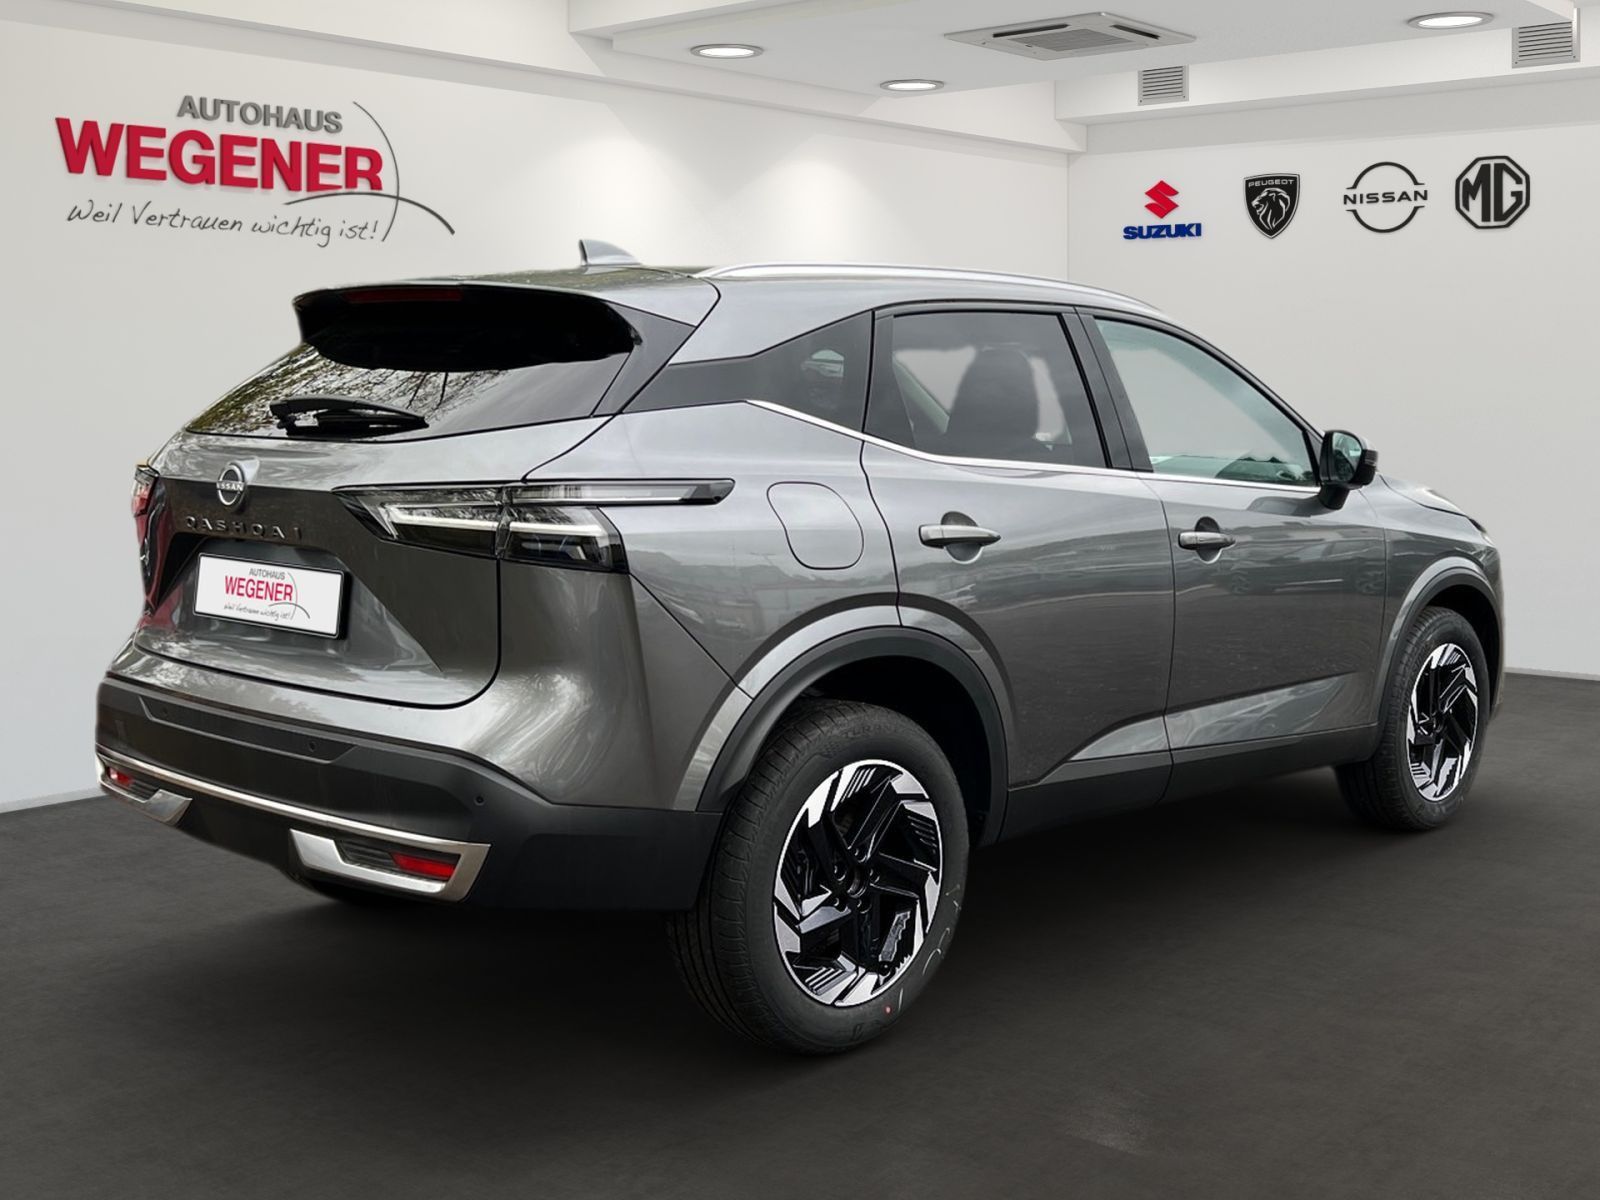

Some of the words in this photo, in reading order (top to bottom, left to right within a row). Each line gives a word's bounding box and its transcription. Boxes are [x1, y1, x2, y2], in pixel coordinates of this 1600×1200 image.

[177, 95, 343, 134] AUTOHAUS
[55, 117, 384, 192] WEGENER
[1248, 178, 1295, 188] PEUGEOT
[1462, 163, 1524, 222] MG
[1343, 190, 1428, 205] NISSAN
[66, 199, 123, 223] Weil
[131, 200, 243, 233] Vertrauen
[251, 215, 331, 248] wichtig
[338, 220, 379, 241] ist!
[1123, 223, 1202, 240] SUZUKI
[185, 515, 303, 540] QASHQAI
[249, 568, 285, 580] AUTOHAUS
[225, 575, 293, 601] WEGENER
